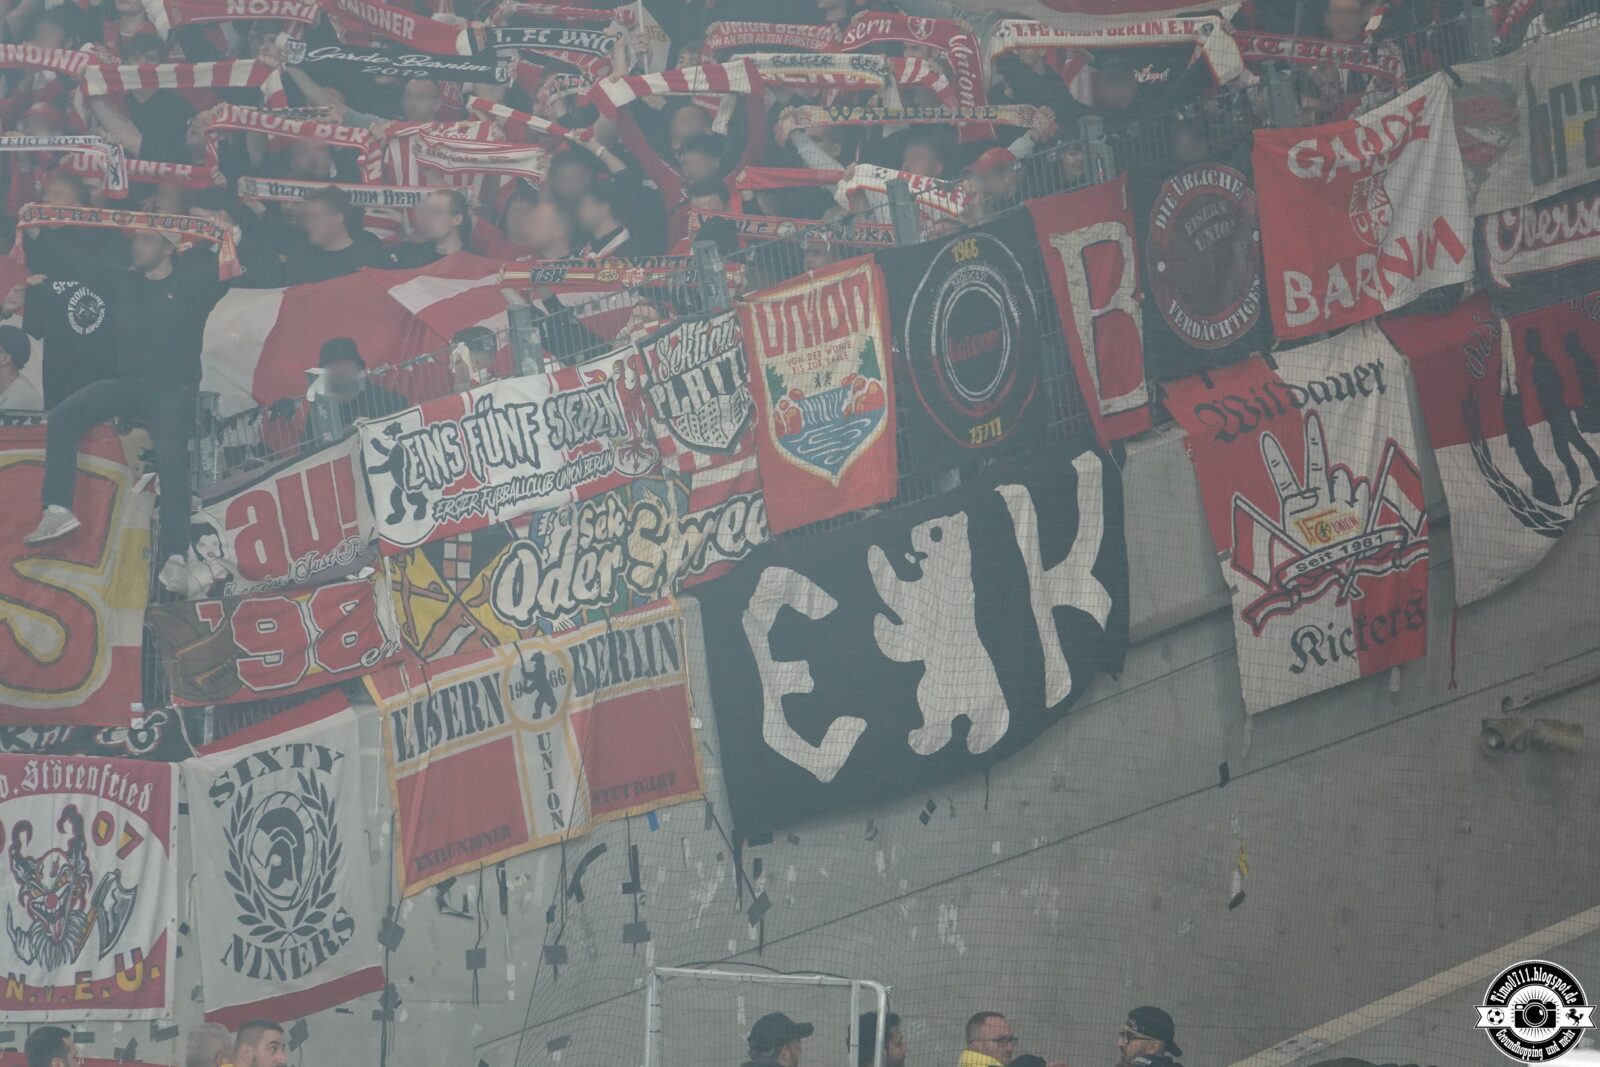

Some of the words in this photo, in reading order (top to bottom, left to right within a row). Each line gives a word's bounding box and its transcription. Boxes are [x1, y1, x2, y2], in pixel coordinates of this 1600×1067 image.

[843, 18, 893, 45] sern
[360, 65, 429, 78] 2019
[1154, 194, 1178, 231] DIE
[754, 274, 871, 357] UNION
[786, 356, 804, 368] VON
[461, 393, 541, 483] FÜNF
[555, 459, 584, 491] UNION
[583, 449, 615, 479] BERLIN
[1339, 534, 1384, 555] 1981
[568, 618, 680, 698] BERLIN
[741, 566, 868, 784] E
[509, 679, 523, 702] 19
[549, 668, 566, 689] 66
[209, 743, 345, 807] SIXTY
[536, 731, 566, 830] UNION
[220, 906, 356, 981] NINERS
